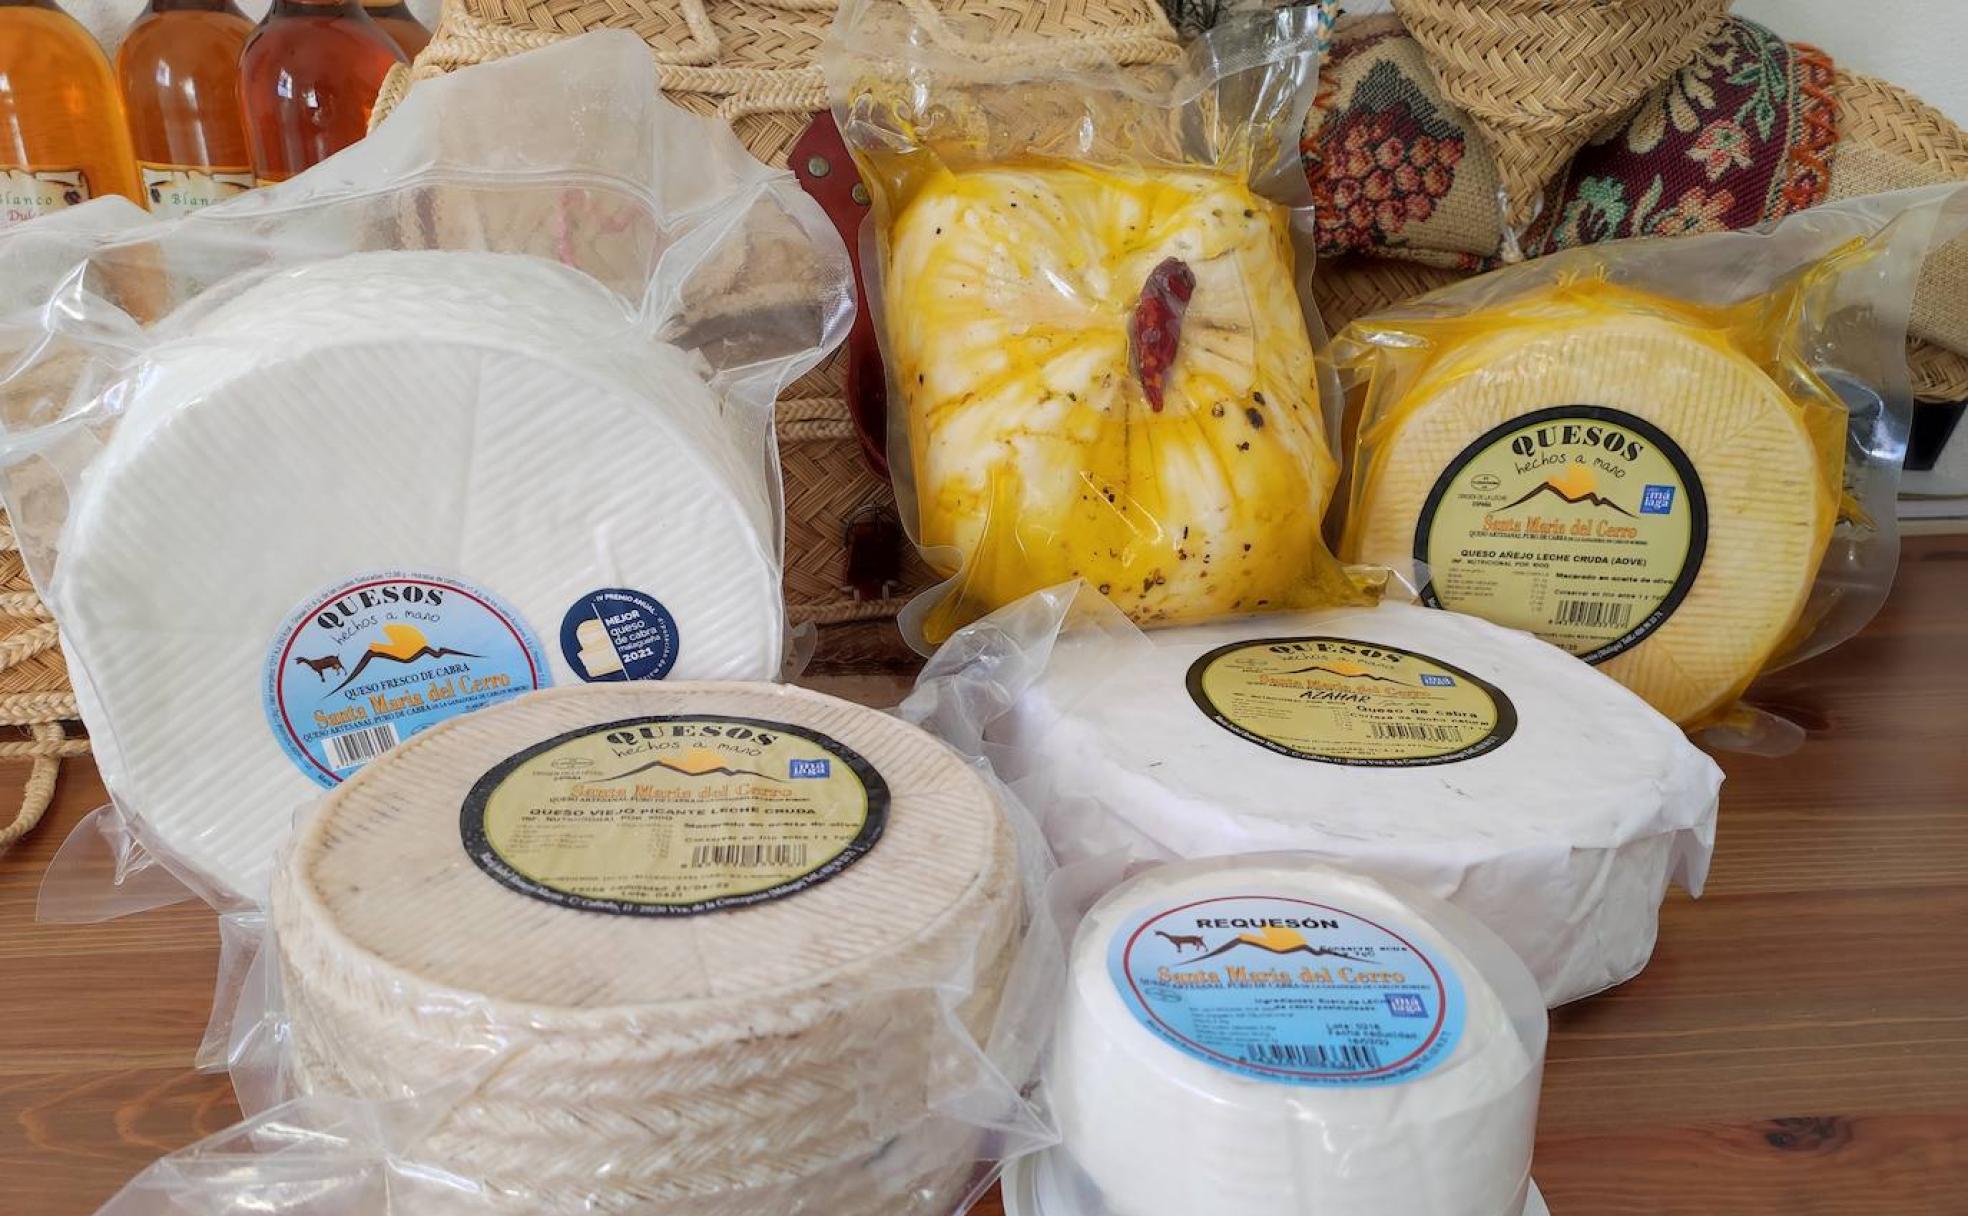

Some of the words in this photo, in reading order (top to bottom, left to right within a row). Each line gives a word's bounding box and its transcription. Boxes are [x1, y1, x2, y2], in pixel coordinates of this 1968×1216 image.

[1512, 425, 1644, 461] QUESOS
[1514, 452, 1567, 475] hechos
[1575, 455, 1586, 464] a
[1593, 457, 1626, 479] mano
[1482, 514, 1522, 532] Santa
[1571, 518, 1593, 536] del
[1596, 519, 1638, 538] Cerro
[1461, 550, 1496, 558] QUESO
[1498, 550, 1534, 560] AÑEJO
[1536, 553, 1571, 562] LECHE
[1573, 555, 1608, 564] CRUDA
[1611, 557, 1646, 566] (AOVE)
[317, 586, 444, 629] QUESOS
[595, 594, 604, 602] IV
[605, 593, 634, 603] PREMIO
[632, 598, 656, 615] ANUAL
[605, 609, 641, 626] MEJOR
[330, 614, 379, 646] hechos
[386, 612, 398, 621] a
[405, 610, 441, 623] mano
[610, 620, 645, 637] queso
[615, 635, 628, 646] de
[628, 626, 658, 642] cabra
[622, 647, 655, 663] 2021
[1269, 643, 1403, 663] QUESOS
[344, 683, 379, 700] QUESO
[380, 673, 420, 691] FRESCO
[421, 668, 436, 682] DE
[435, 662, 471, 678] CABRA
[313, 702, 368, 730] Santa
[427, 680, 456, 703] del
[458, 672, 512, 696] Cerro
[1299, 691, 1371, 703] AZAHAR
[1356, 705, 1404, 714] Queso
[1410, 706, 1428, 715] de
[1436, 708, 1479, 719] cabra
[303, 728, 328, 743] QUESO
[328, 718, 374, 737] ARTESANAL
[374, 713, 394, 725] PURO
[406, 704, 432, 717] CABRA
[606, 725, 779, 747] QUESOS
[611, 741, 681, 758] hechos
[692, 741, 709, 749] a
[572, 784, 626, 799] Santa
[736, 783, 793, 798] Cerro
[530, 808, 585, 817] QUESO
[590, 807, 636, 816] VIEJO
[640, 808, 706, 817] PICANTE
[711, 806, 761, 815] LECHE
[1196, 917, 1339, 930] REQUESÓN
[1157, 965, 1220, 984] Santa
[1298, 965, 1334, 984] del
[1337, 965, 1407, 985] Cerro
